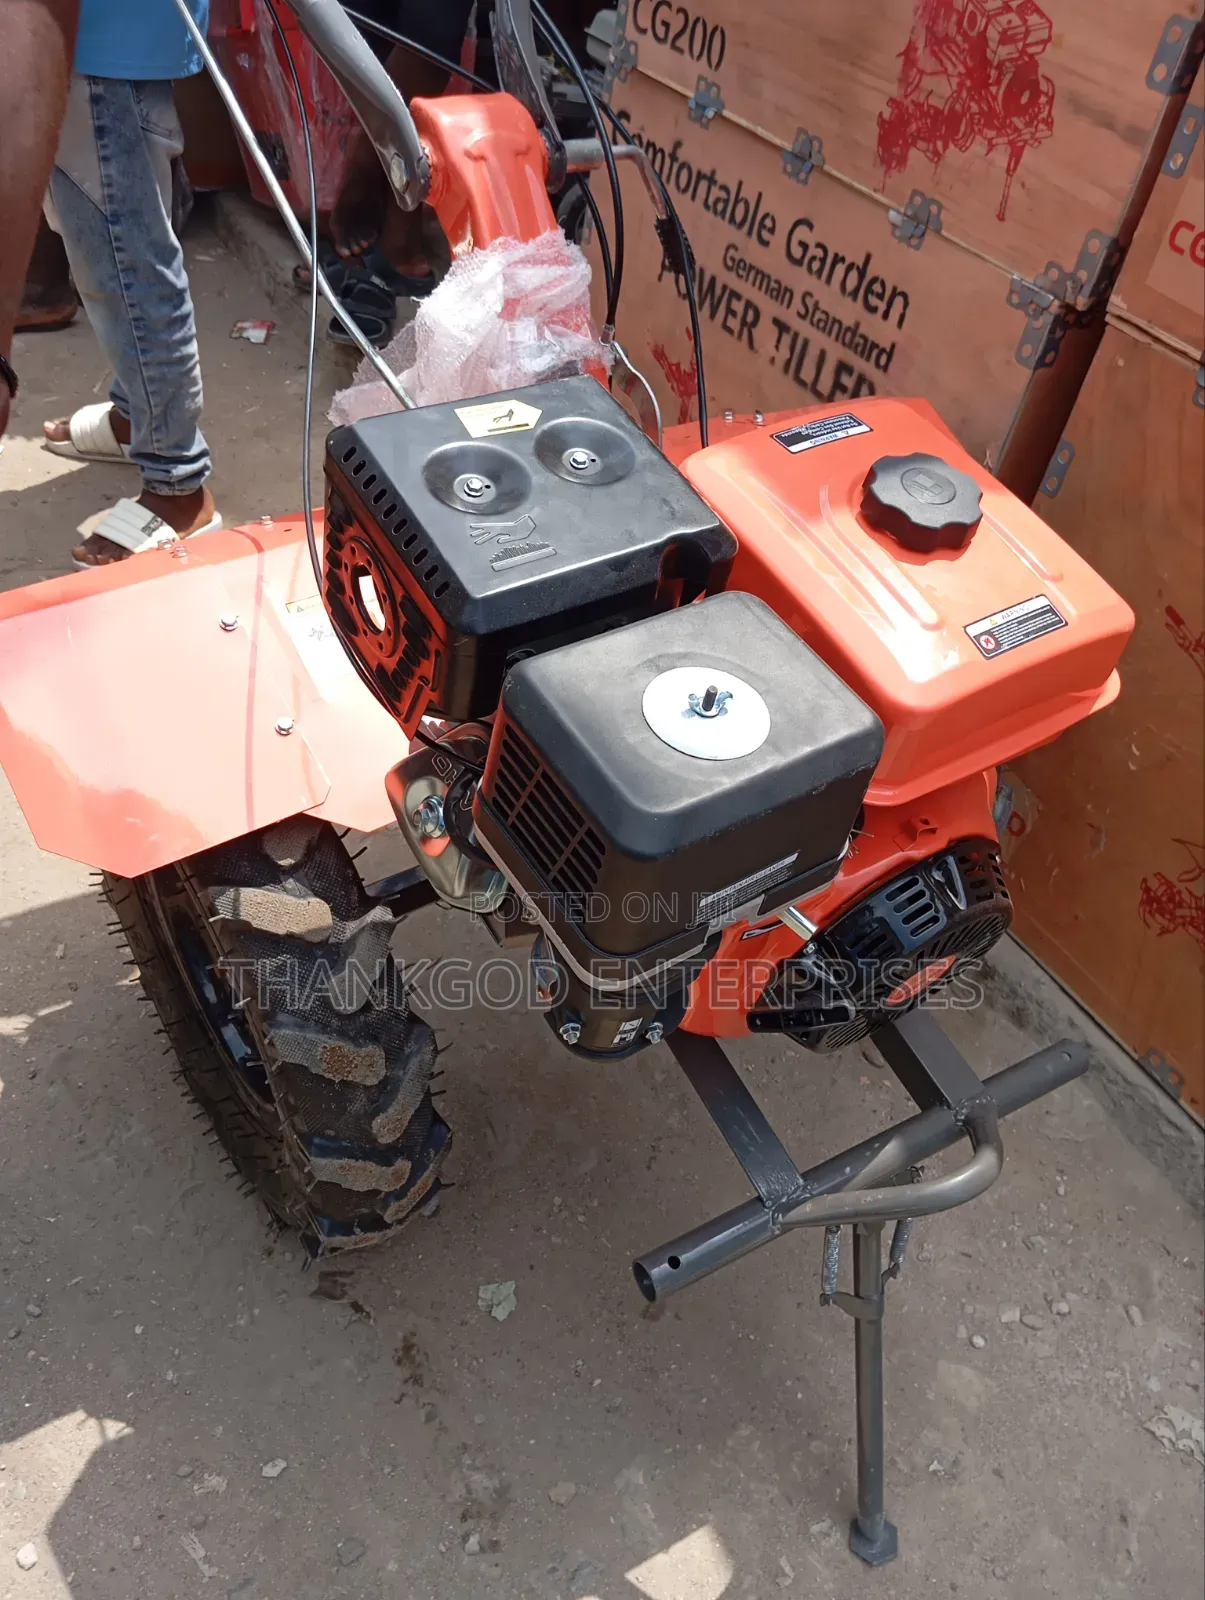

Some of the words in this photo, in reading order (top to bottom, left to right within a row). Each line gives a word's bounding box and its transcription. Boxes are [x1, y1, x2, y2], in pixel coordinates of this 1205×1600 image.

[632, 0, 725, 72] CG200
[722, 243, 794, 310] German
[796, 290, 896, 373] Standard
[785, 217, 909, 330] Garden
